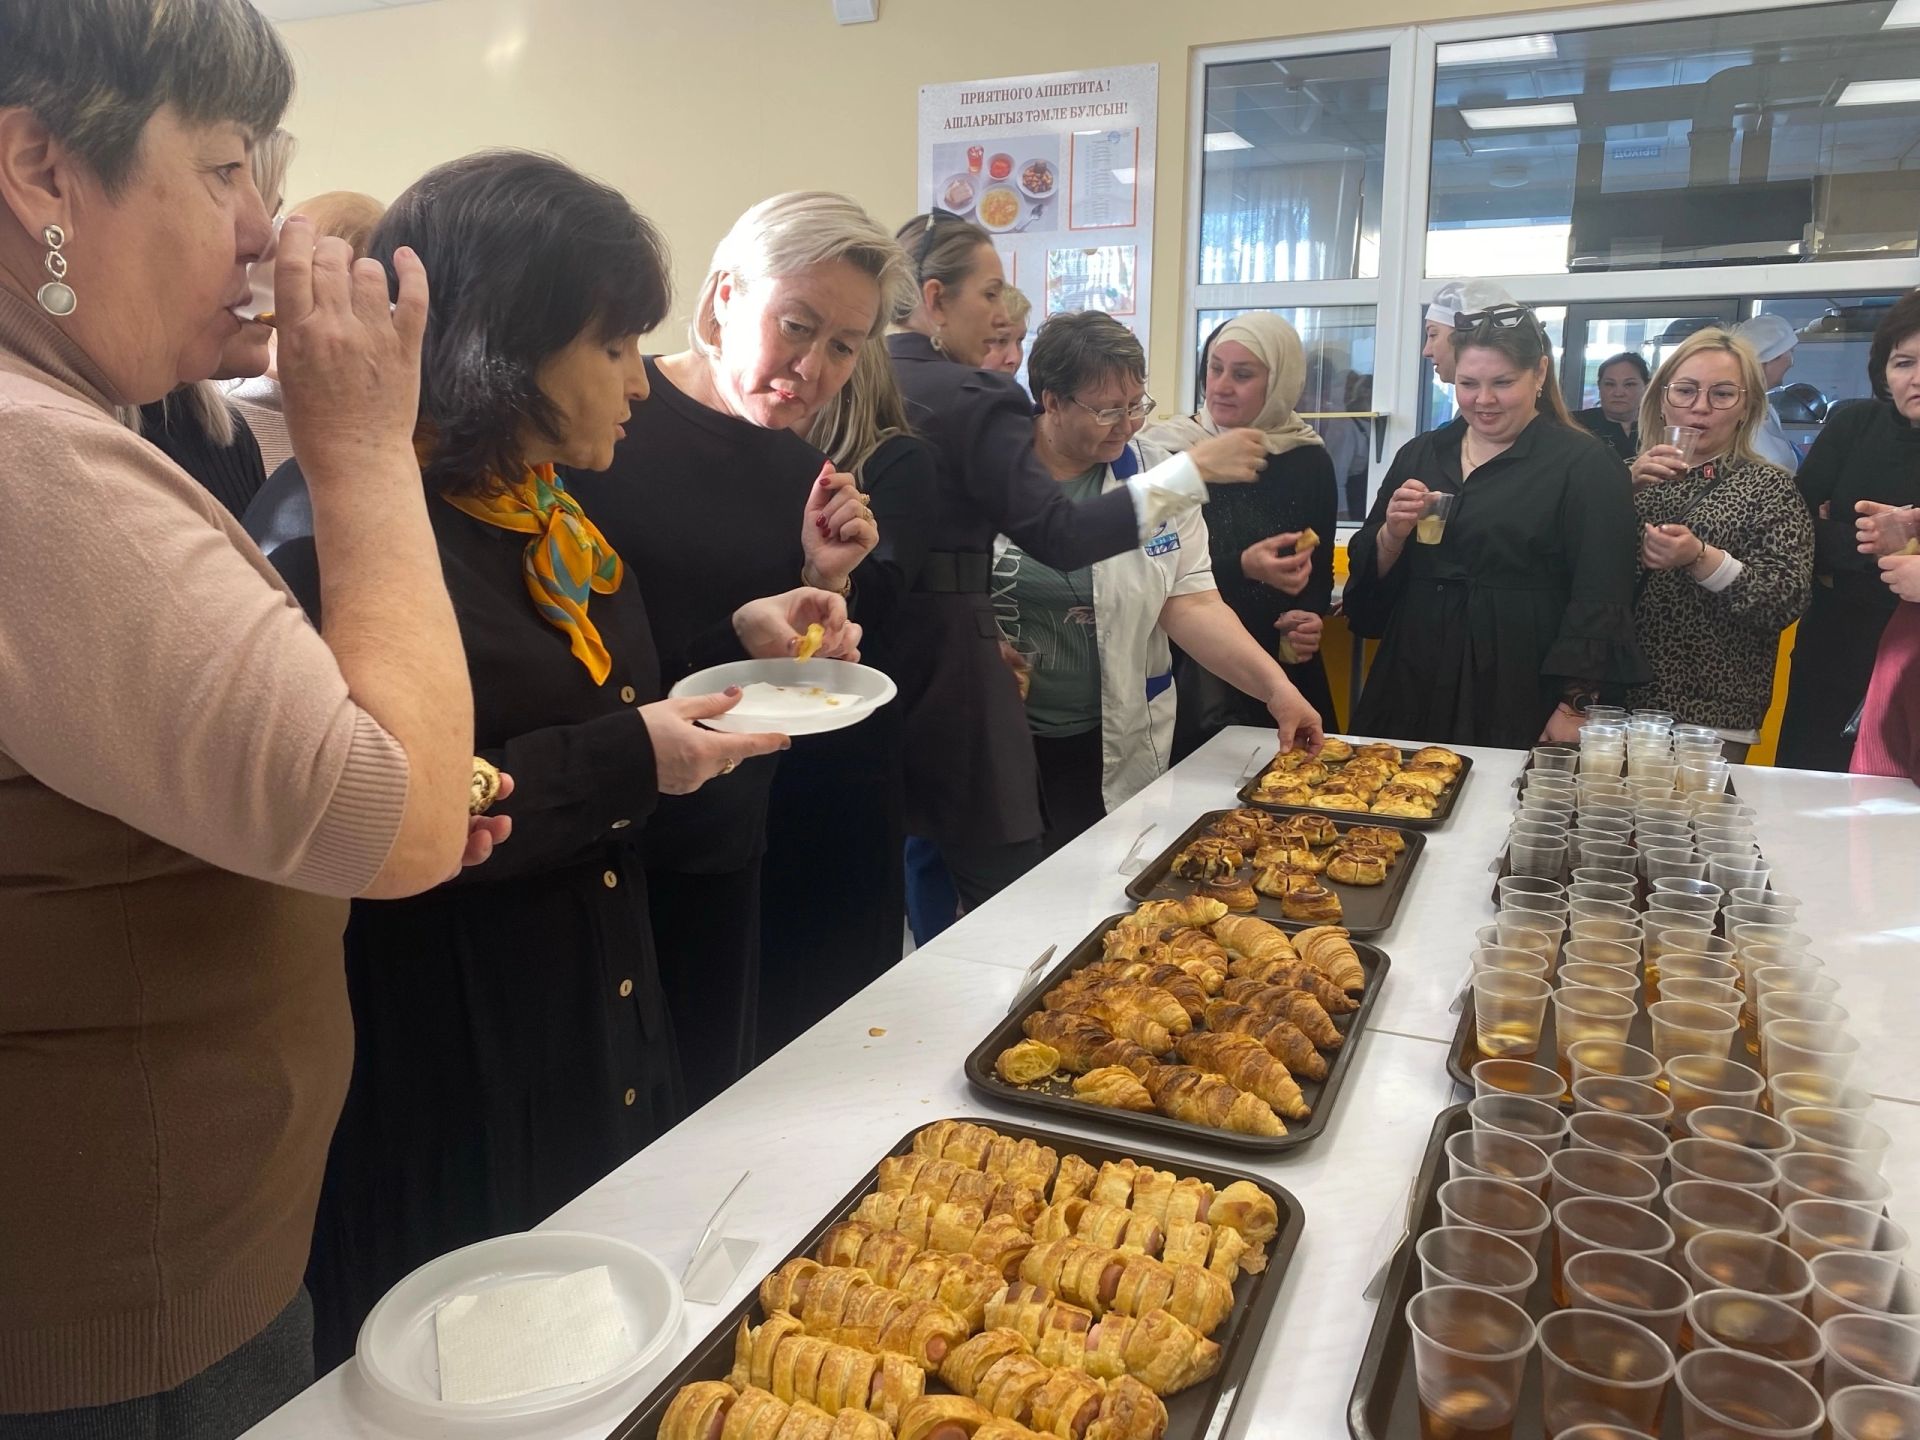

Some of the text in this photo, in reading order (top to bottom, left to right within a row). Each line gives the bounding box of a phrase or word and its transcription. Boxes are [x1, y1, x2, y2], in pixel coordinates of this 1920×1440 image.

[960, 86, 1033, 105] ПРИЯТНОГО
[1035, 80, 1104, 98] АППЕТИТА
[943, 102, 1128, 130] АШЛАРЫГЫЗ ТӘМЛЕ БУЛСЫН!
